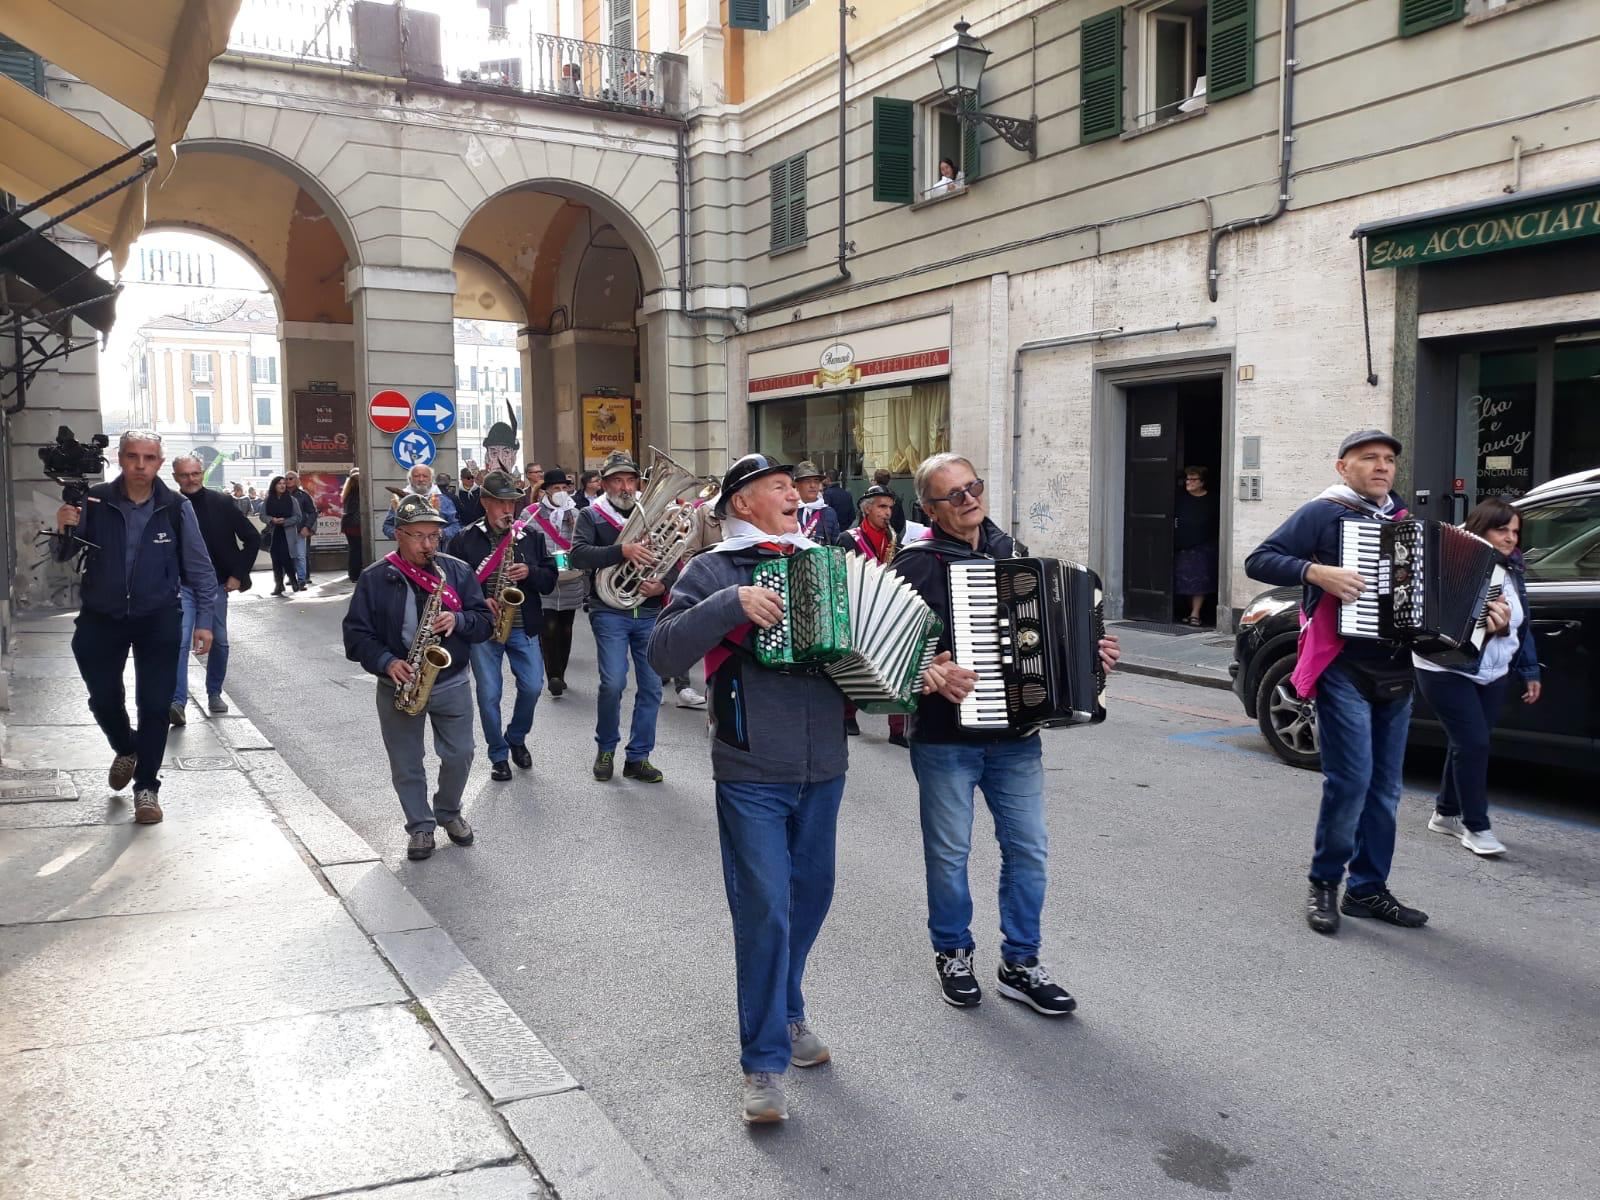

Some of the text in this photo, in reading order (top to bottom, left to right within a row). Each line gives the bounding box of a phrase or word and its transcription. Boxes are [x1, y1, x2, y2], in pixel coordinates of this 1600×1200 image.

[1371, 240, 1416, 265] Elsa
[867, 351, 940, 374] CAFFETTERIA
[1467, 395, 1512, 424] Elsa
[591, 431, 624, 441] Mercati
